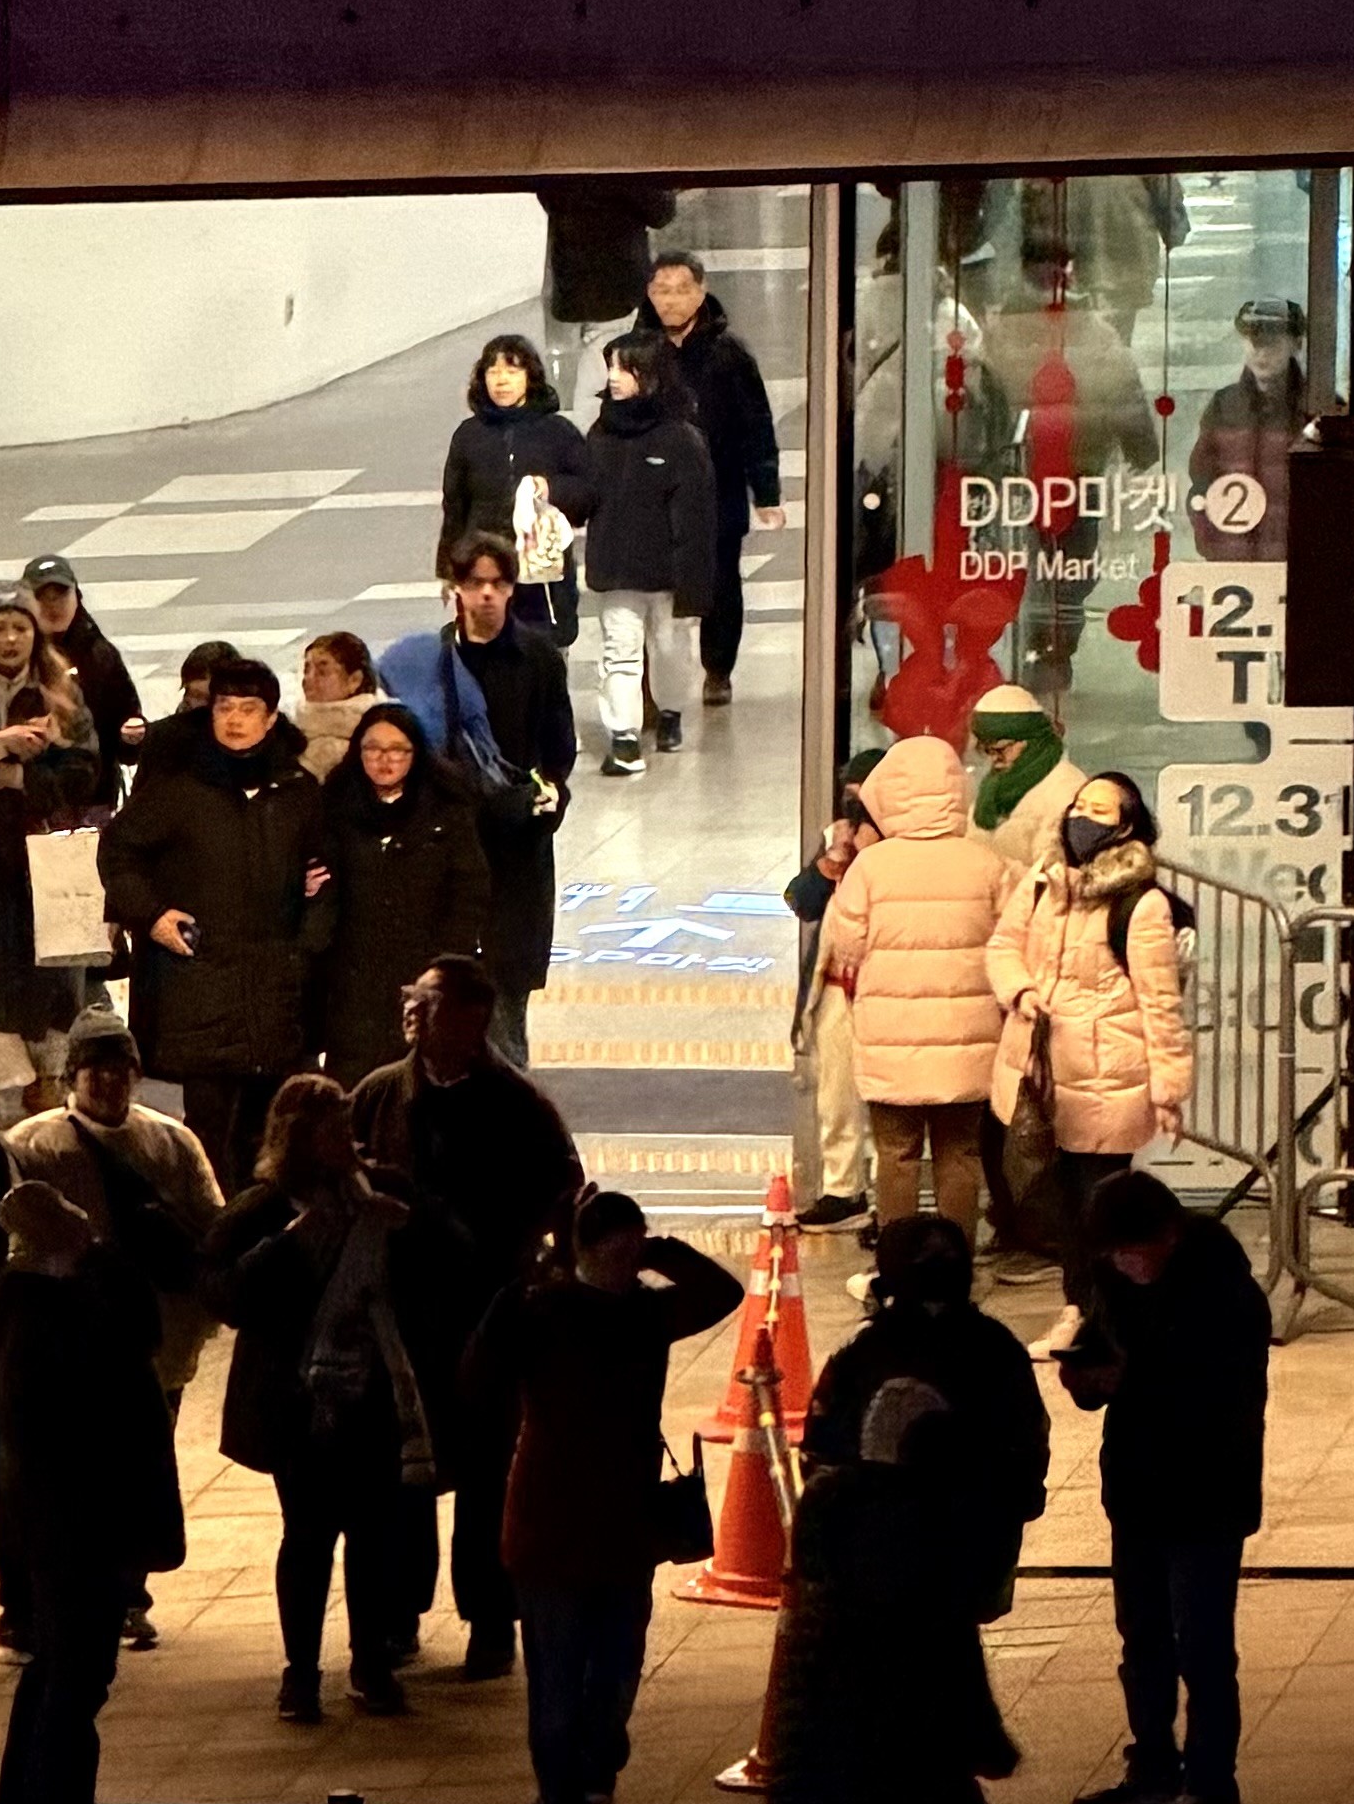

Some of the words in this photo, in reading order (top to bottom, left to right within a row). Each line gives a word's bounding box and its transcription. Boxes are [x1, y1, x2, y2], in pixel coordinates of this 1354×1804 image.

[959, 473, 1177, 533] DDP마켓
[1221, 481, 1250, 527] 2
[959, 550, 1028, 581] DDP
[1036, 549, 1140, 582] Market
[549, 945, 776, 973] DP마켓
